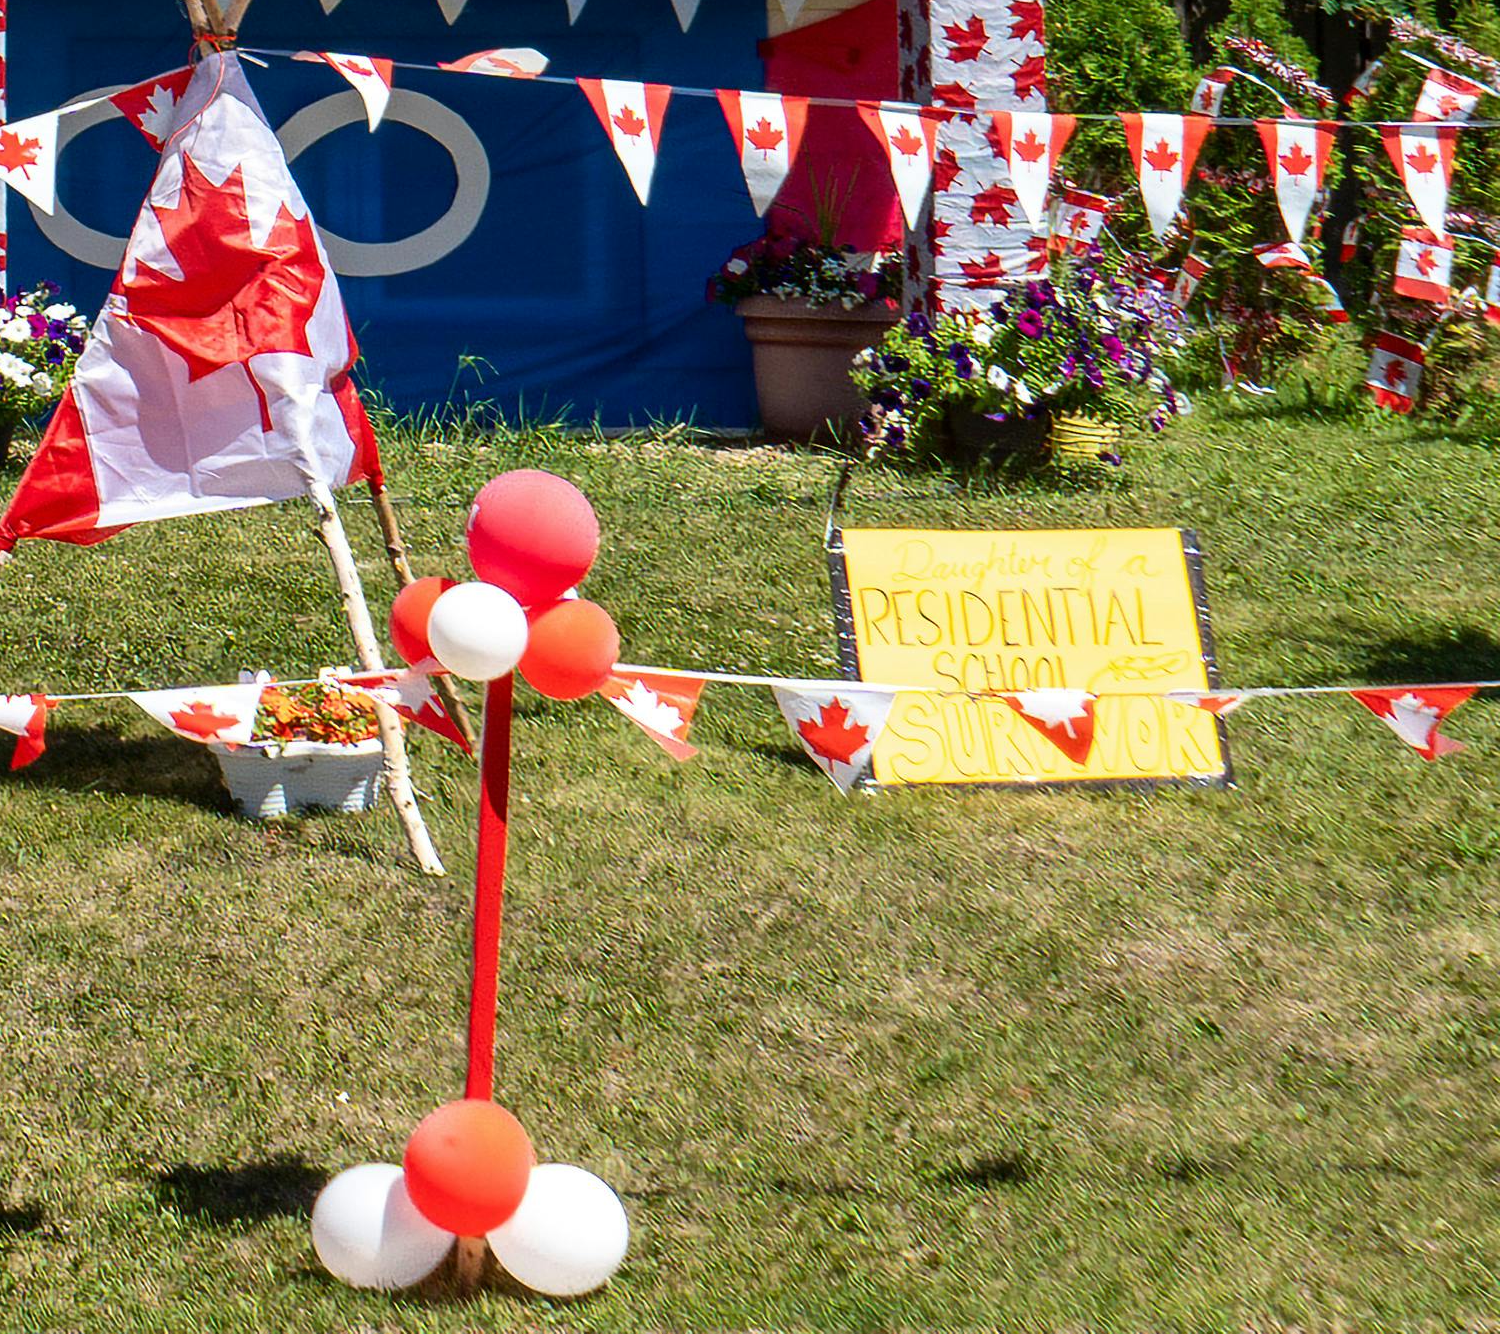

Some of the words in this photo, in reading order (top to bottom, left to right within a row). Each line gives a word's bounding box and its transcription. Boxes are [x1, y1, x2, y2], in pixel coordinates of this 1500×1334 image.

[892, 538, 1053, 590] Daughter
[1064, 533, 1109, 593] of
[1116, 552, 1162, 579] a
[857, 586, 1164, 647] RESIDENTIAL
